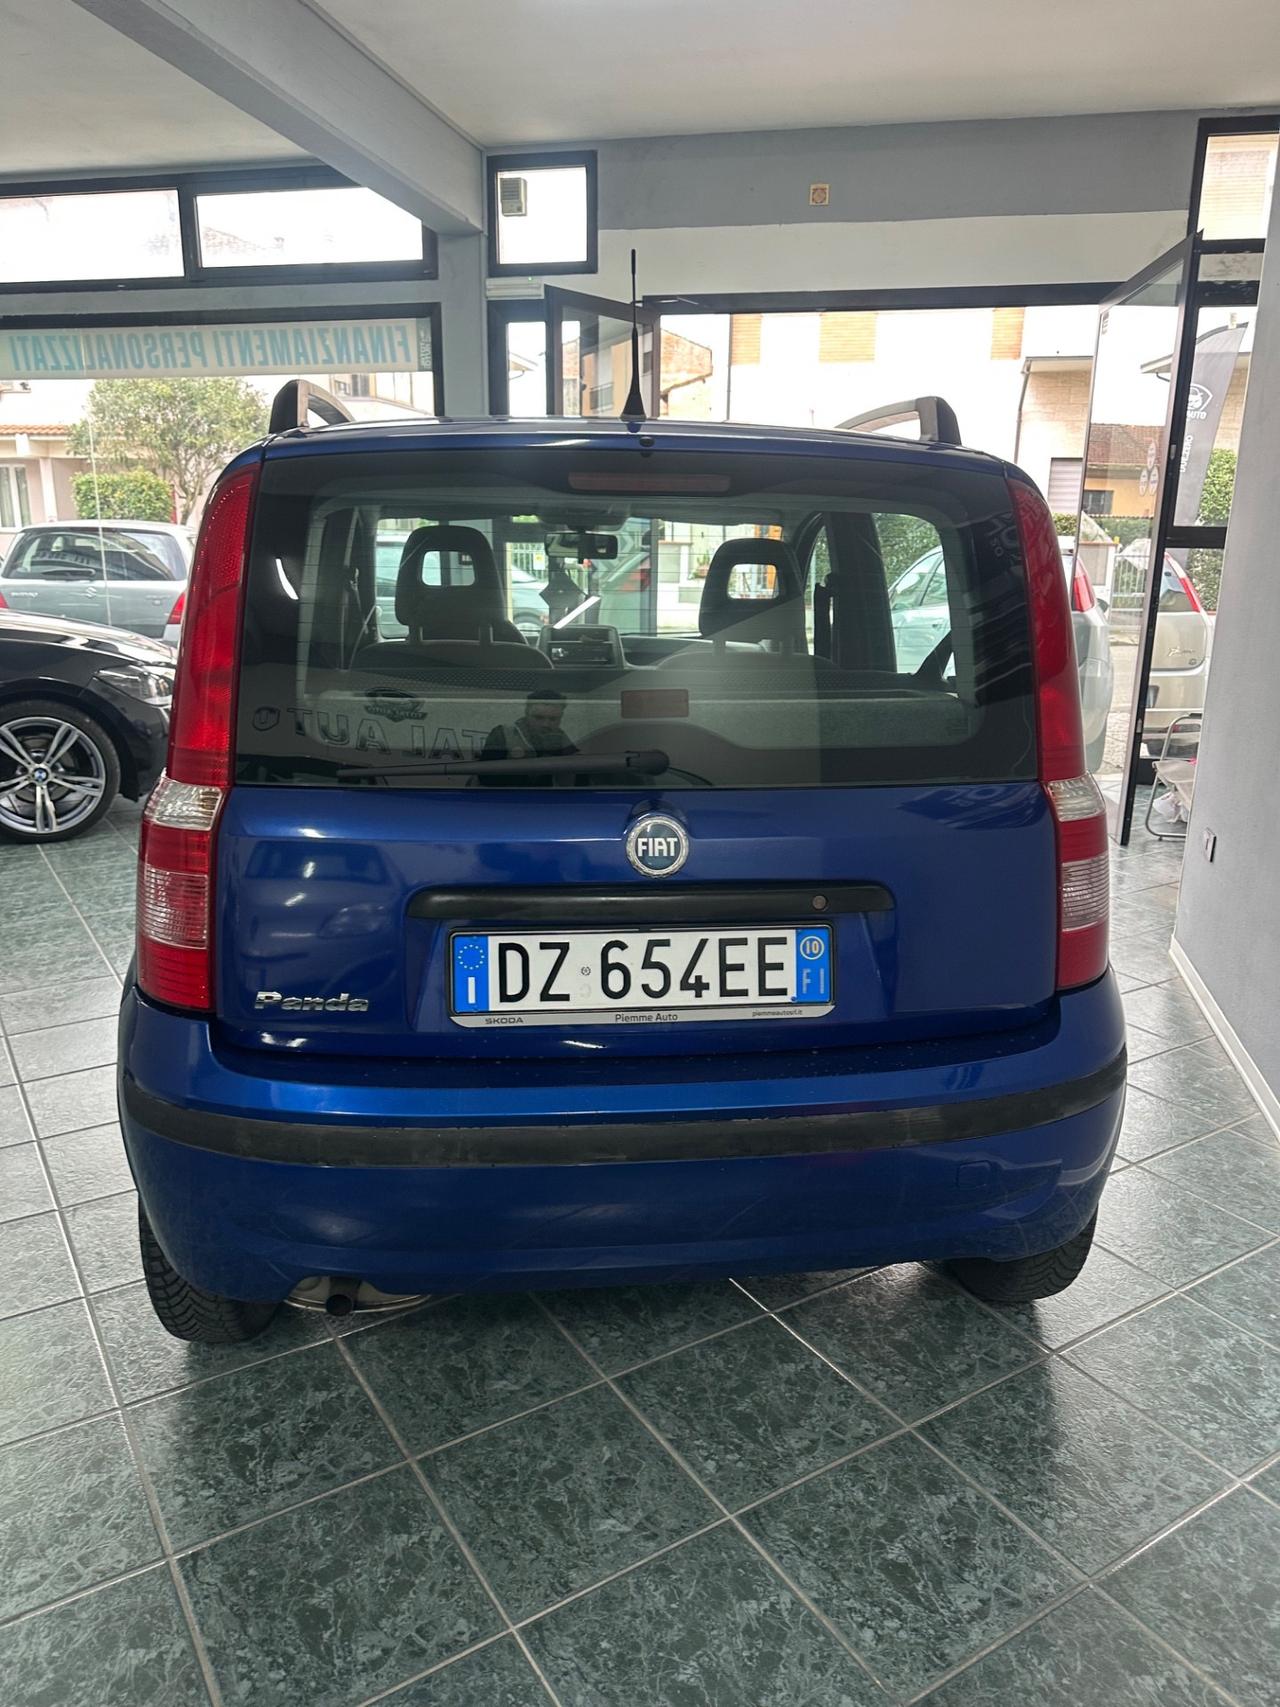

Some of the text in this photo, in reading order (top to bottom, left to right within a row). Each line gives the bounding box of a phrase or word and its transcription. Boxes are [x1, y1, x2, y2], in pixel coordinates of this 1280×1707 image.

[637, 838, 678, 857] FIAT
[806, 940, 820, 954] 10
[499, 941, 570, 1002] DZ
[600, 937, 788, 1000] 654EE
[802, 968, 824, 994] FI
[254, 991, 369, 1012] Panda
[615, 1012, 679, 1023] Piemme Auto
